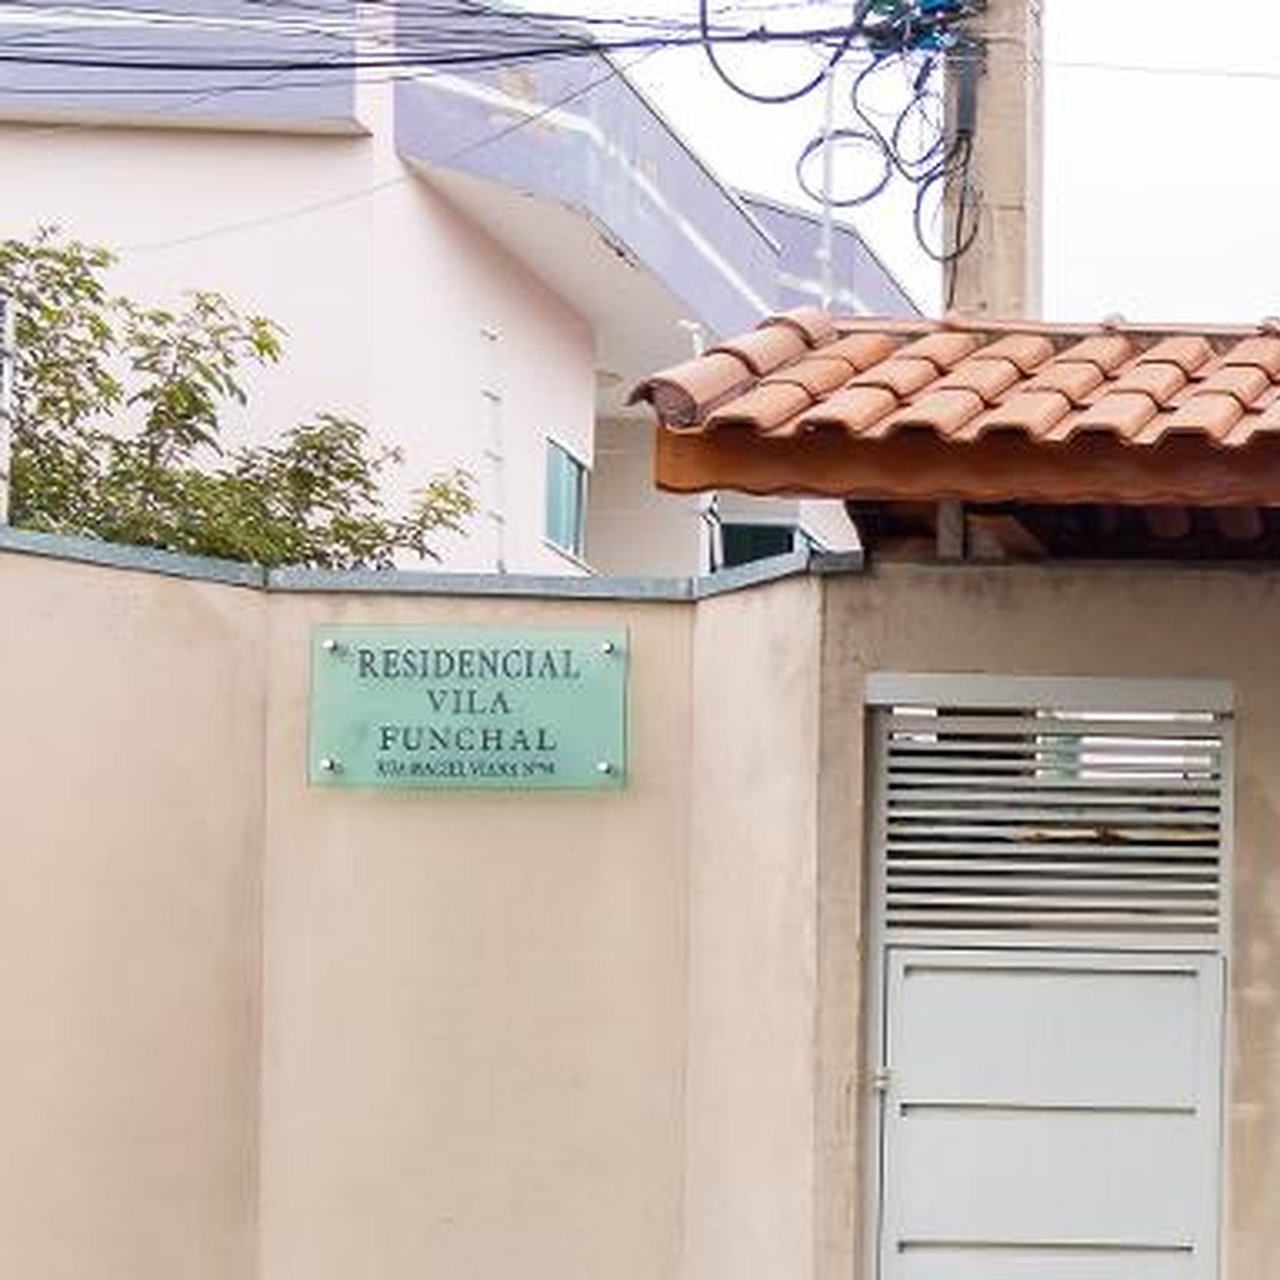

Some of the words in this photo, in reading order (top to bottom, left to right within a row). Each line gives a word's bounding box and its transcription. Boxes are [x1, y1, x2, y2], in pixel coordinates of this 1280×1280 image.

[358, 649, 581, 679] RESIDENCIAL
[427, 690, 513, 715] VILA
[379, 726, 557, 752] FUNCHAL
